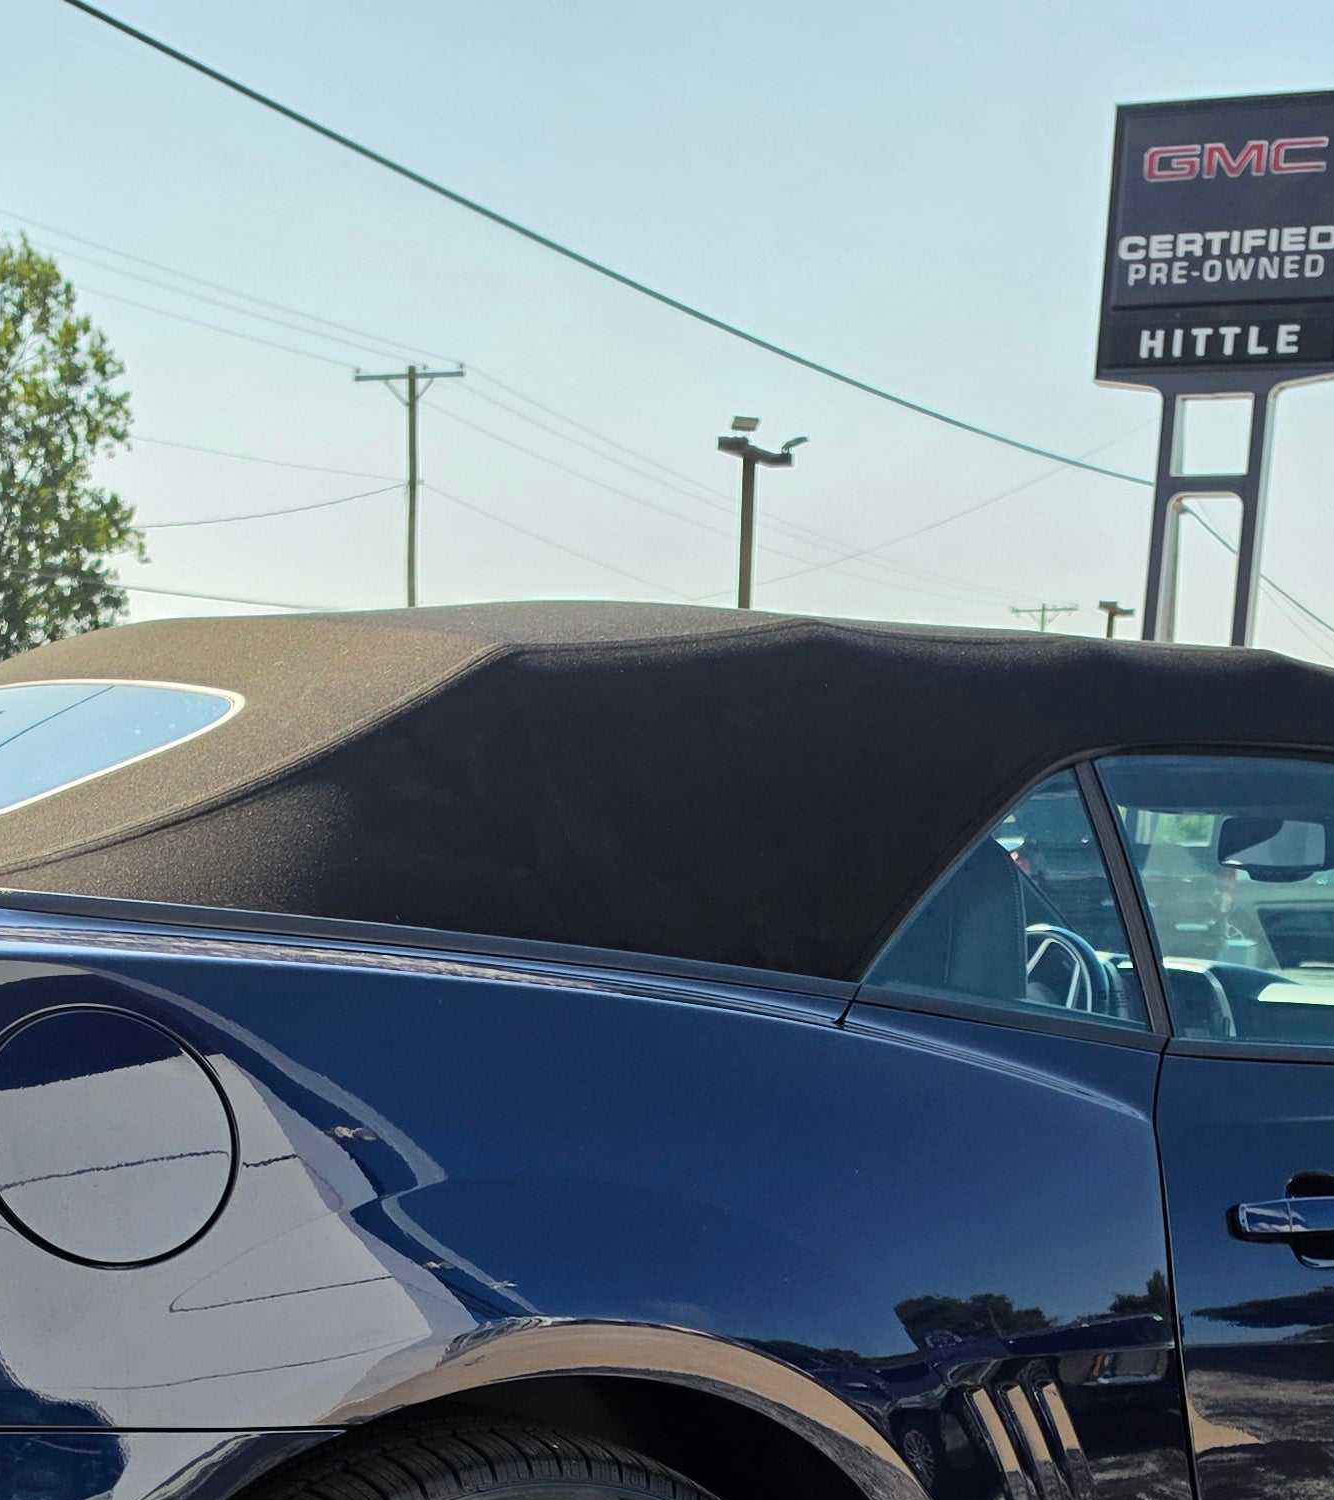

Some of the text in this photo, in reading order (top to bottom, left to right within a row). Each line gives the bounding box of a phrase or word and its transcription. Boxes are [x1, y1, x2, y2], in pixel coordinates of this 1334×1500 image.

[1144, 136, 1329, 182] GMC
[1127, 254, 1325, 286] PRE-OWNED
[1138, 324, 1301, 358] HITTLE
